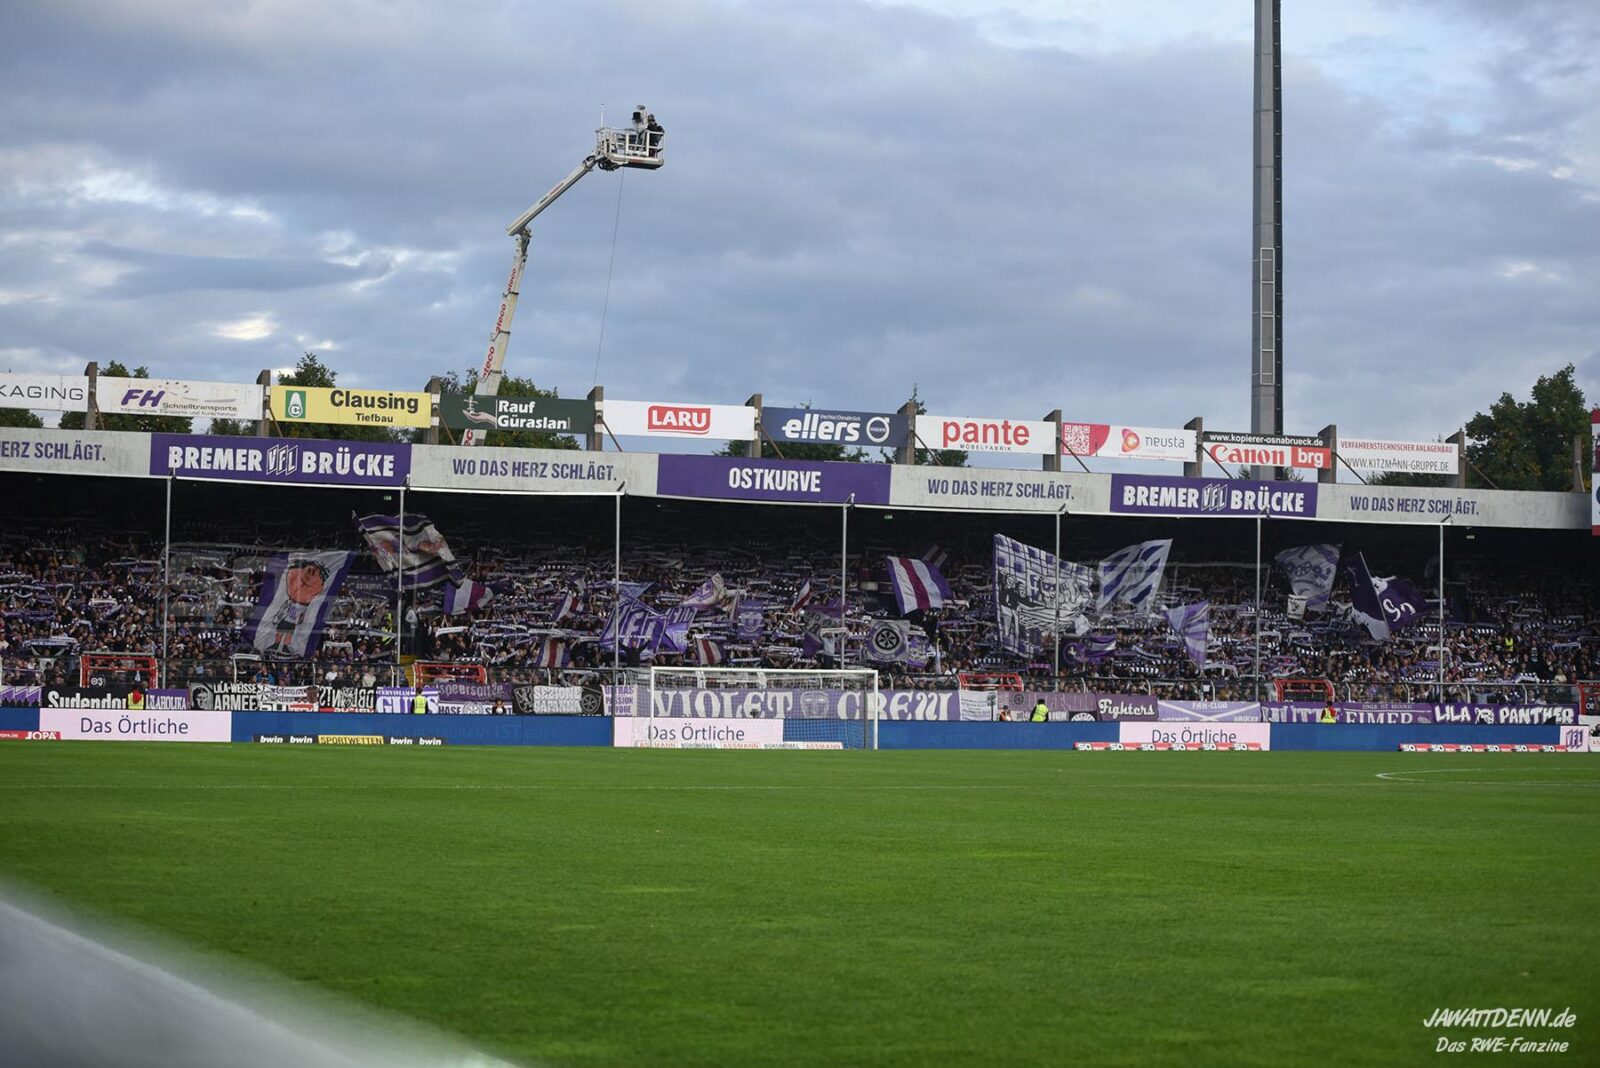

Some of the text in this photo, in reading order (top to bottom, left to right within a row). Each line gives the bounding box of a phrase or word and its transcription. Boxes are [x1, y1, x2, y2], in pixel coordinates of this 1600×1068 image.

[121, 389, 165, 407] FH
[330, 390, 419, 414] Clausing
[163, 402, 238, 413] Schnelltransporte
[499, 400, 535, 414] Rauf
[355, 413, 393, 422] Tiefbau
[498, 414, 568, 430] Güraslan
[652, 409, 707, 428] LARU
[782, 413, 860, 441] ellers
[943, 420, 1029, 448] pante
[1145, 435, 1184, 448] neusta
[1209, 433, 1323, 447] www.kopierer-osnabrueck.de
[1416, 444, 1452, 453] ANLAGENBAU
[0, 440, 106, 461] ERZ SCHLÄGT.
[1210, 444, 1323, 467] Canon brg
[168, 446, 262, 472] BREMER
[302, 447, 394, 477] BRÜCKE
[453, 459, 617, 481] WO DAS HERZ SCHLÄGT.
[729, 466, 821, 493] OSTKURVE
[928, 478, 1074, 500] WO DAS HERZ SCHLÄGT.
[1123, 485, 1199, 508] BREMER
[1231, 486, 1304, 512] BRÜCKE
[1350, 496, 1369, 511] WO
[1372, 497, 1394, 512] DAS
[1397, 498, 1425, 513] HERZ
[605, 686, 633, 695] UTRAS
[214, 695, 257, 711] ARMEE
[648, 691, 793, 718] VIOLET
[837, 691, 952, 720] CREW
[1099, 699, 1155, 718] Fighters
[1435, 705, 1471, 722] LILA
[81, 714, 189, 734] Das Örtliche
[648, 723, 745, 740] Das Örtliche
[25, 732, 57, 740] JOPA
[260, 735, 442, 745] bwin bwin SPORTWETTEN bwin bwin
[1152, 726, 1237, 743] Das Örtliche
